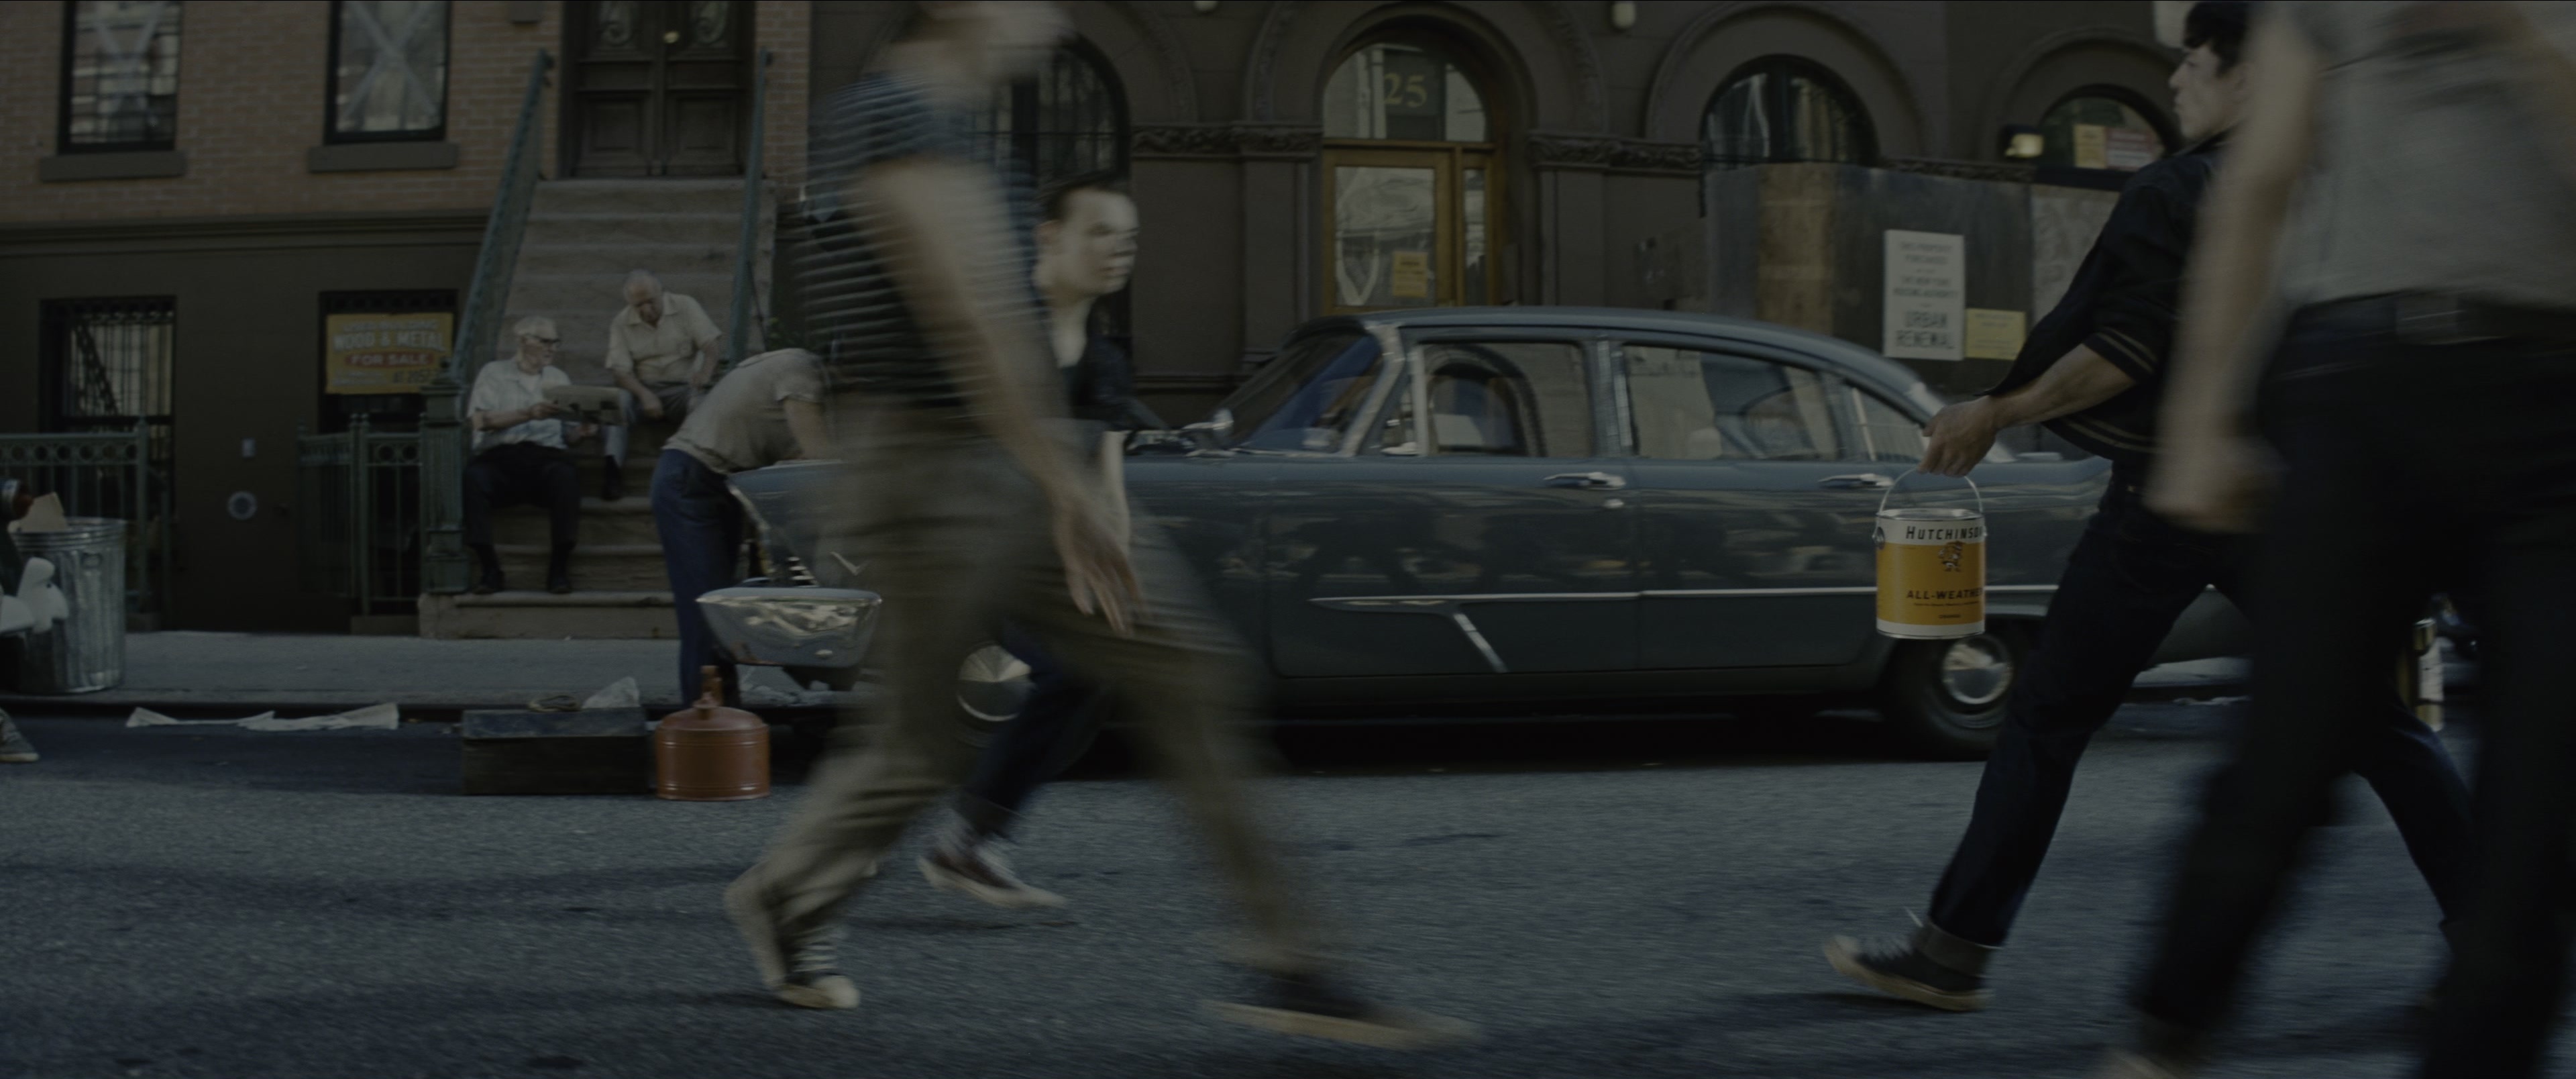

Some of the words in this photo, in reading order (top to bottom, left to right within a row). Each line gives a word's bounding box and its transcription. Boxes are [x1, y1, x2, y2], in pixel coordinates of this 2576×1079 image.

[1383, 72, 1428, 108] 25
[333, 332, 375, 351] WOOD
[380, 331, 390, 348] &
[396, 331, 446, 352] METAL
[350, 354, 383, 366] FOR
[388, 353, 429, 365] SALE
[1907, 587, 1984, 600] ALL-WEATHE
